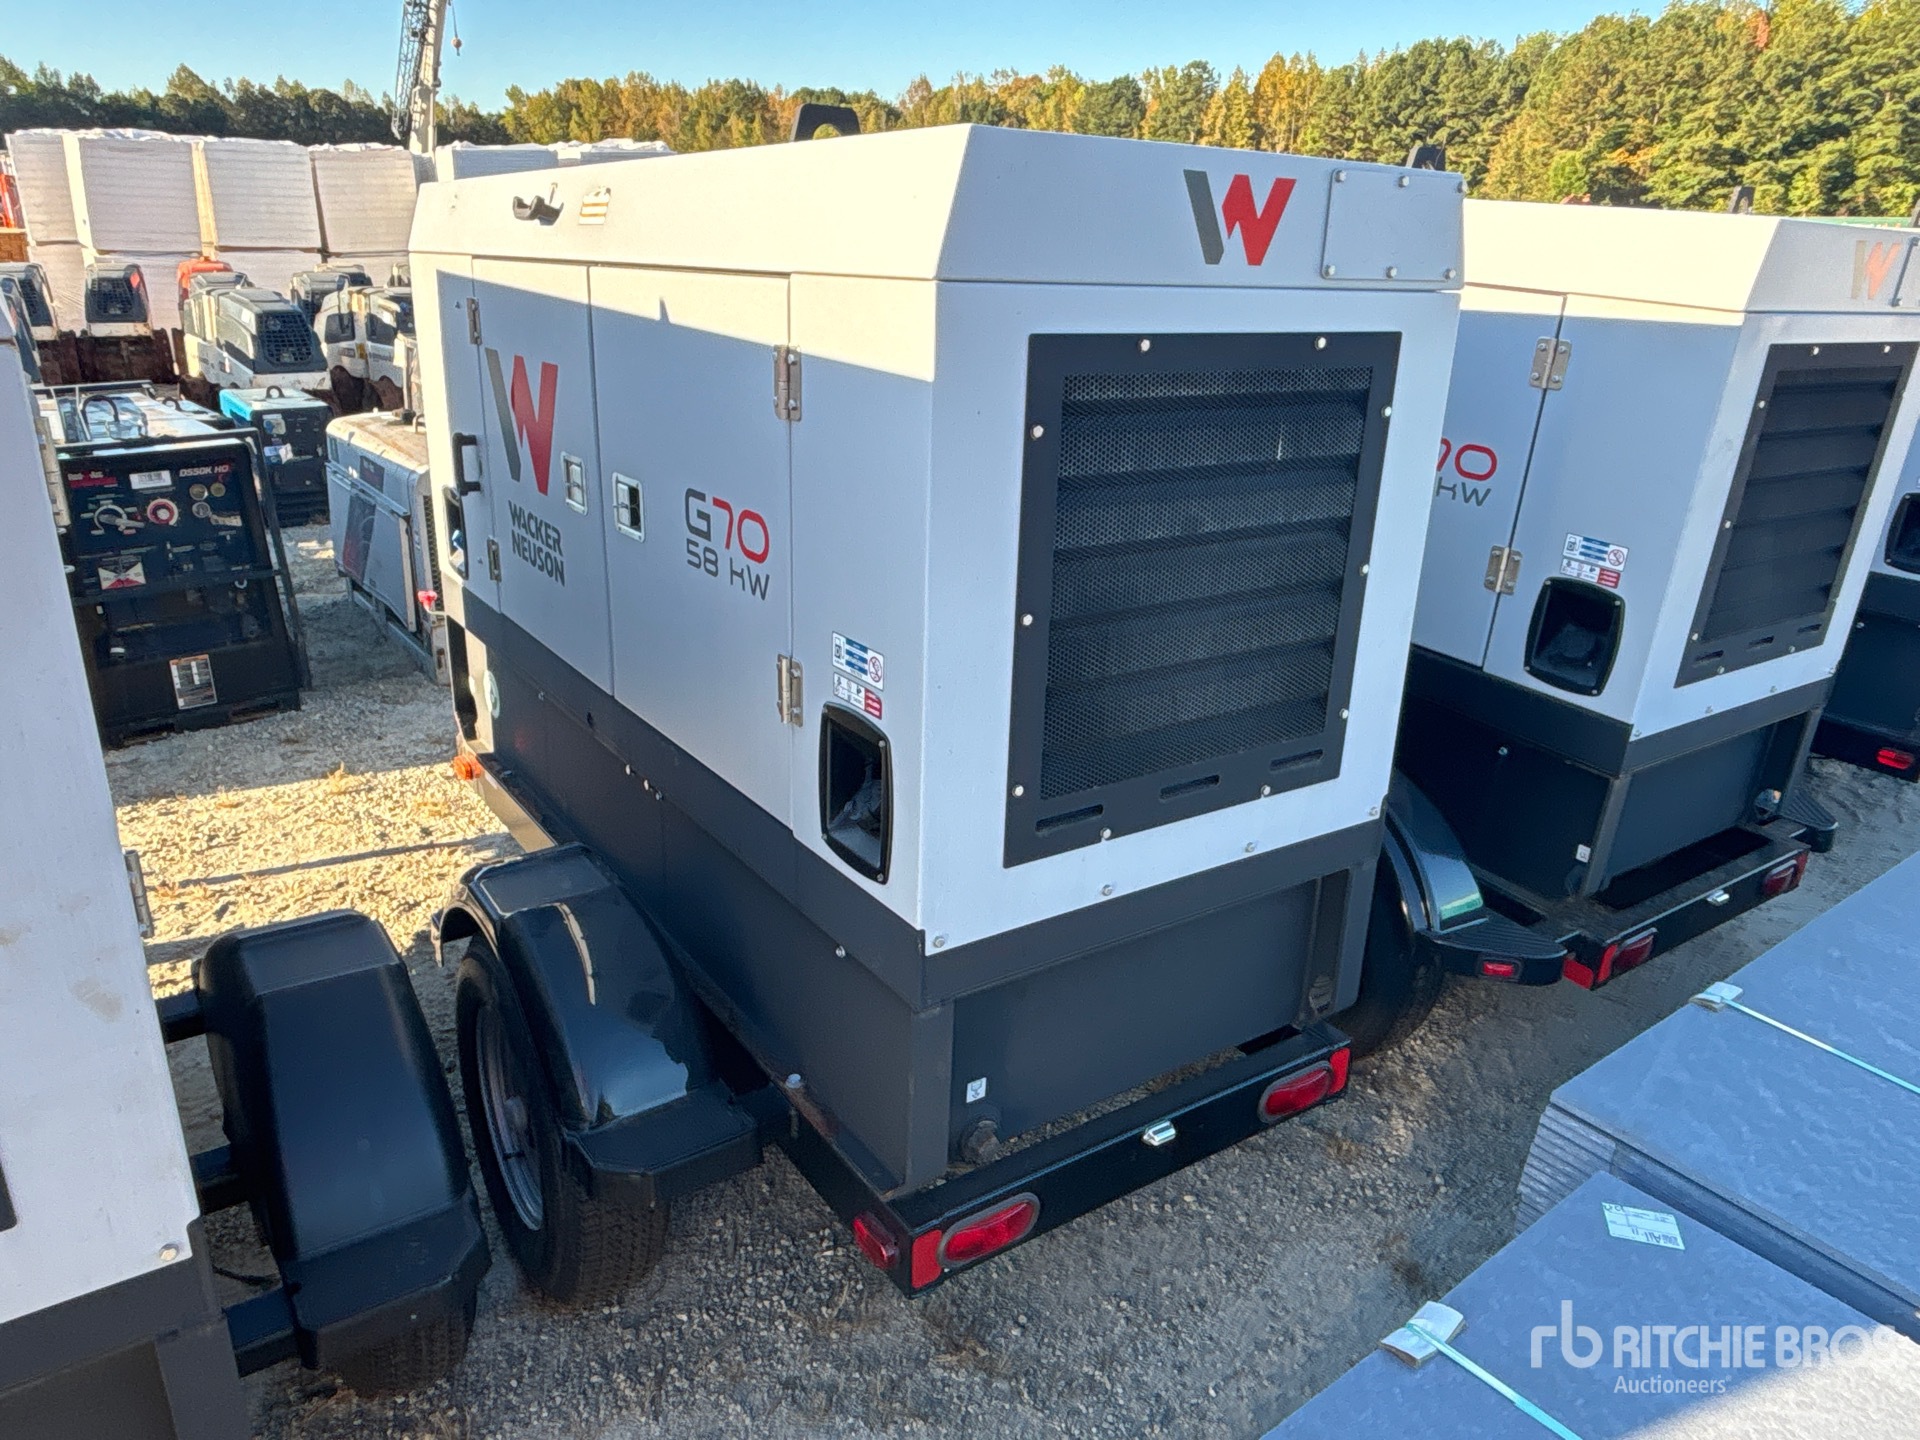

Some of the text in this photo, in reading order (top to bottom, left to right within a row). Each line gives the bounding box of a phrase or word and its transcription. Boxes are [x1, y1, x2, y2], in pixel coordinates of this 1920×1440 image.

[508, 499, 564, 557] WACKER
[685, 487, 770, 564] G70
[511, 529, 566, 587] NEUSON
[686, 538, 719, 578] 58
